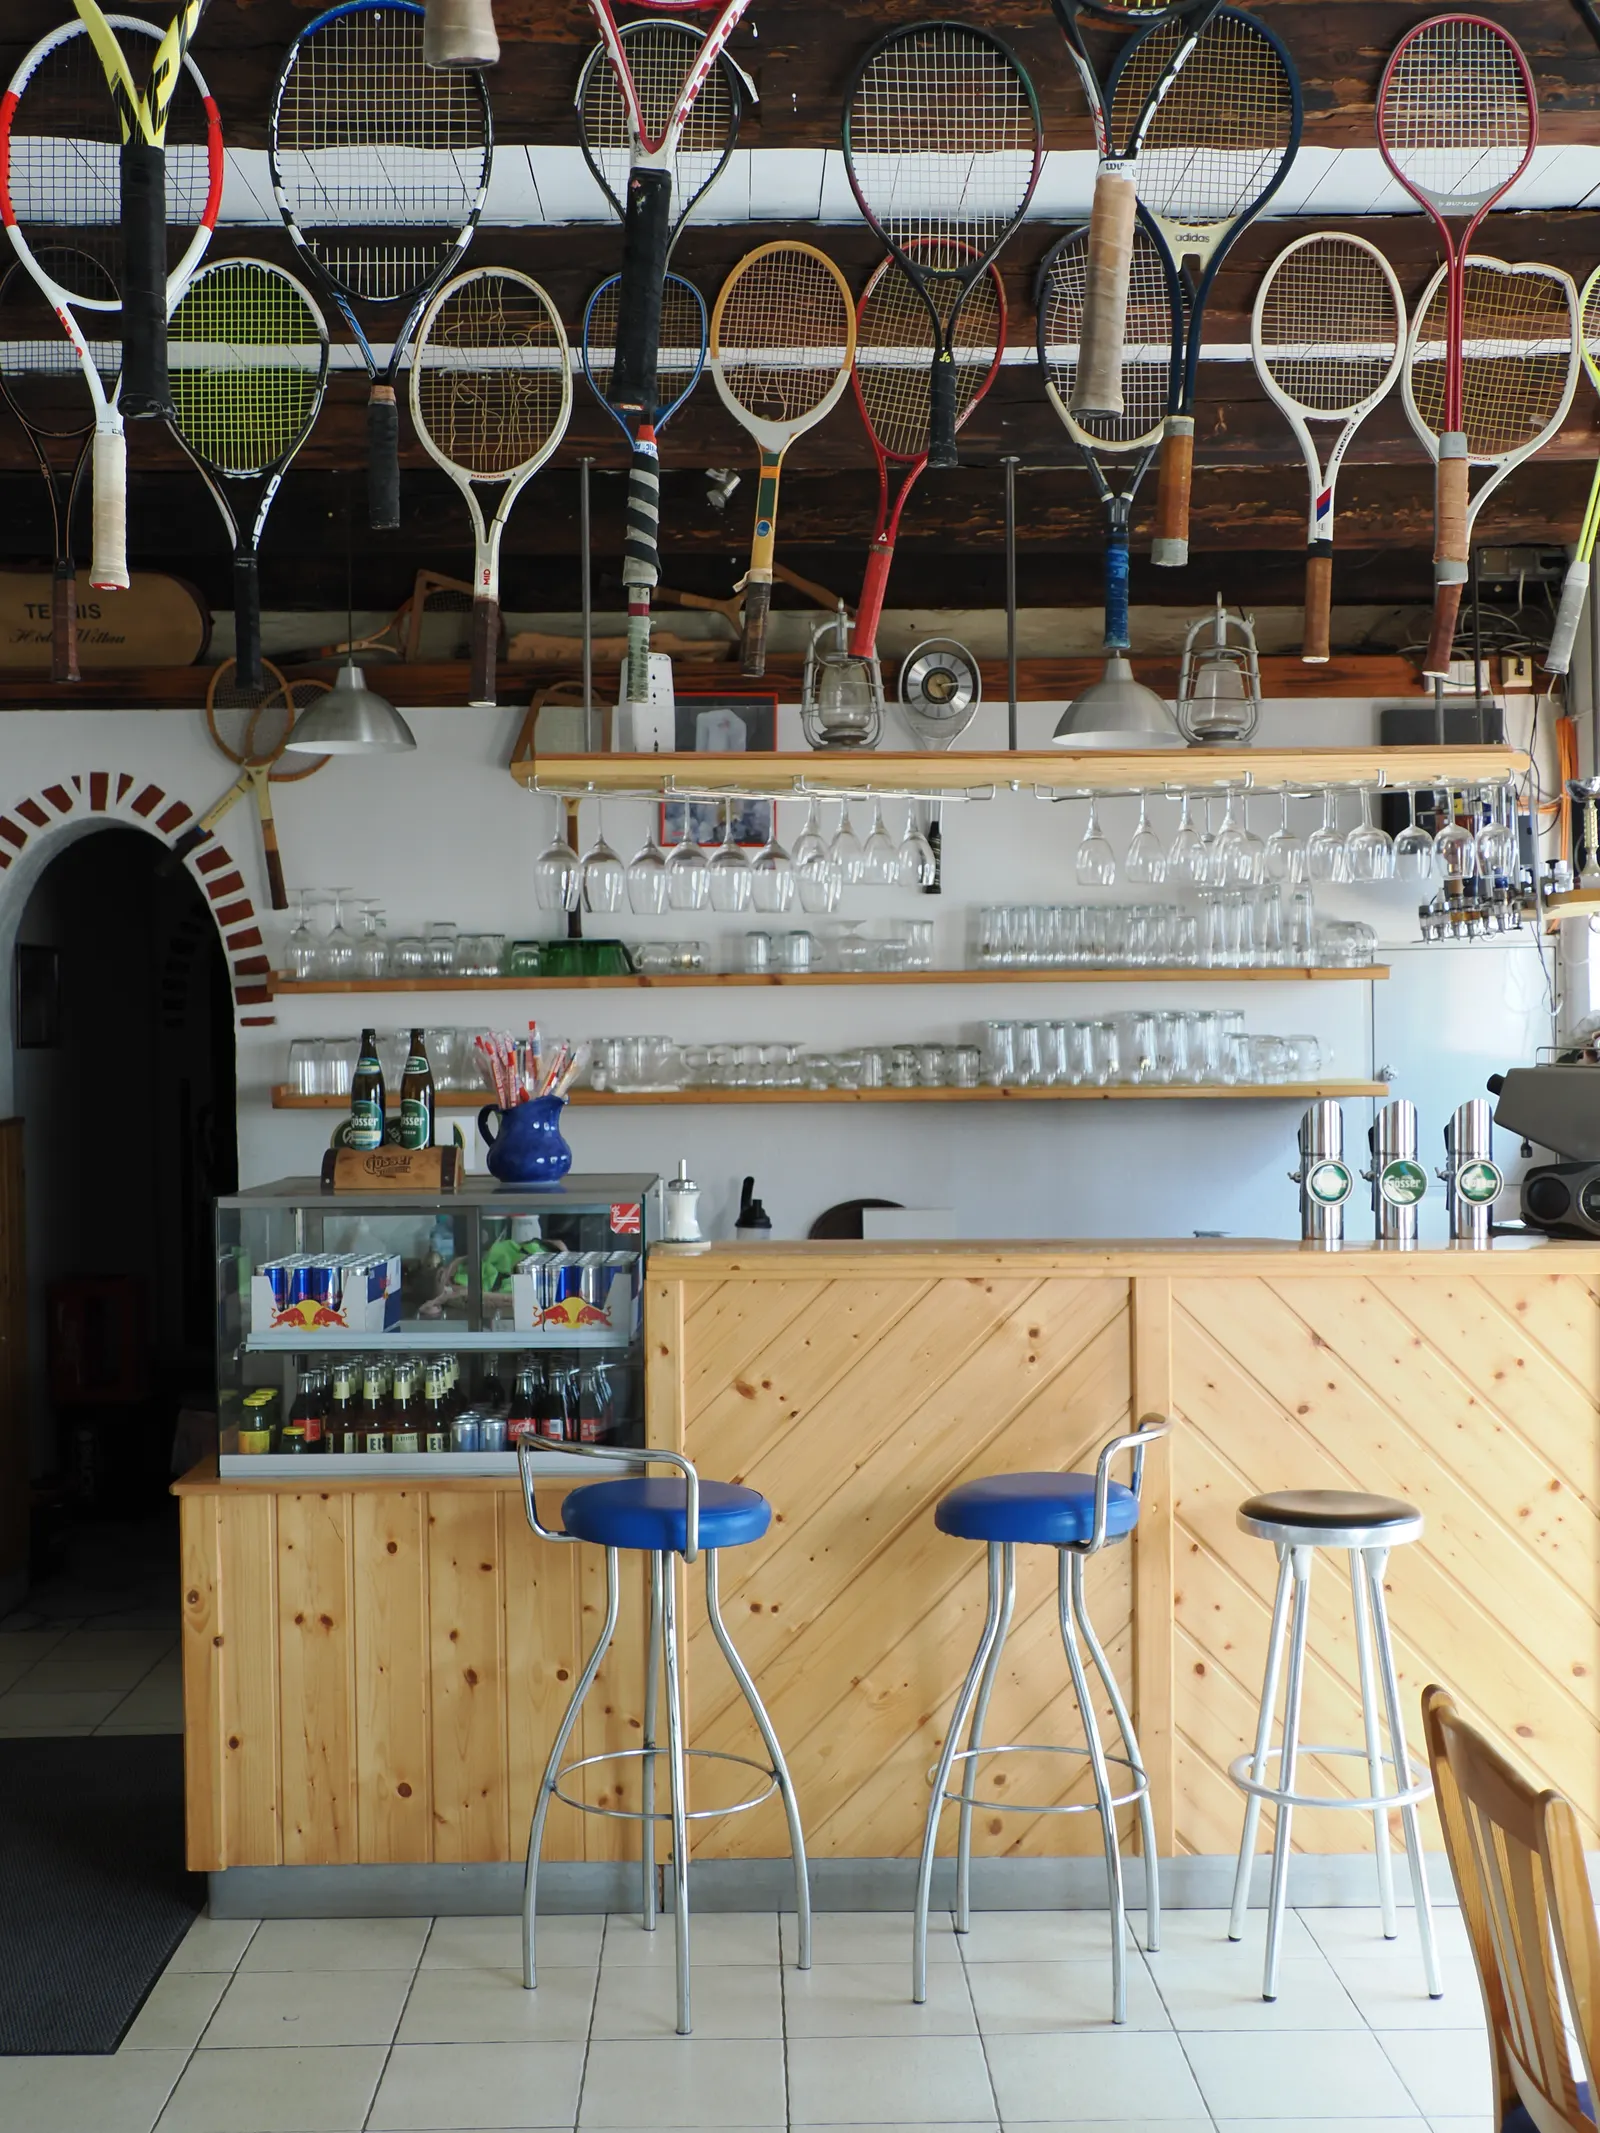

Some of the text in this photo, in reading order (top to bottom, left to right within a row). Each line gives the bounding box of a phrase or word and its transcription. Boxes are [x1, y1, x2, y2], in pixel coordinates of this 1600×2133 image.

[1175, 232, 1210, 243] adidas
[483, 568, 491, 586] MID
[24, 603, 101, 619] TEIS
[1384, 1175, 1421, 1188] Gösser
